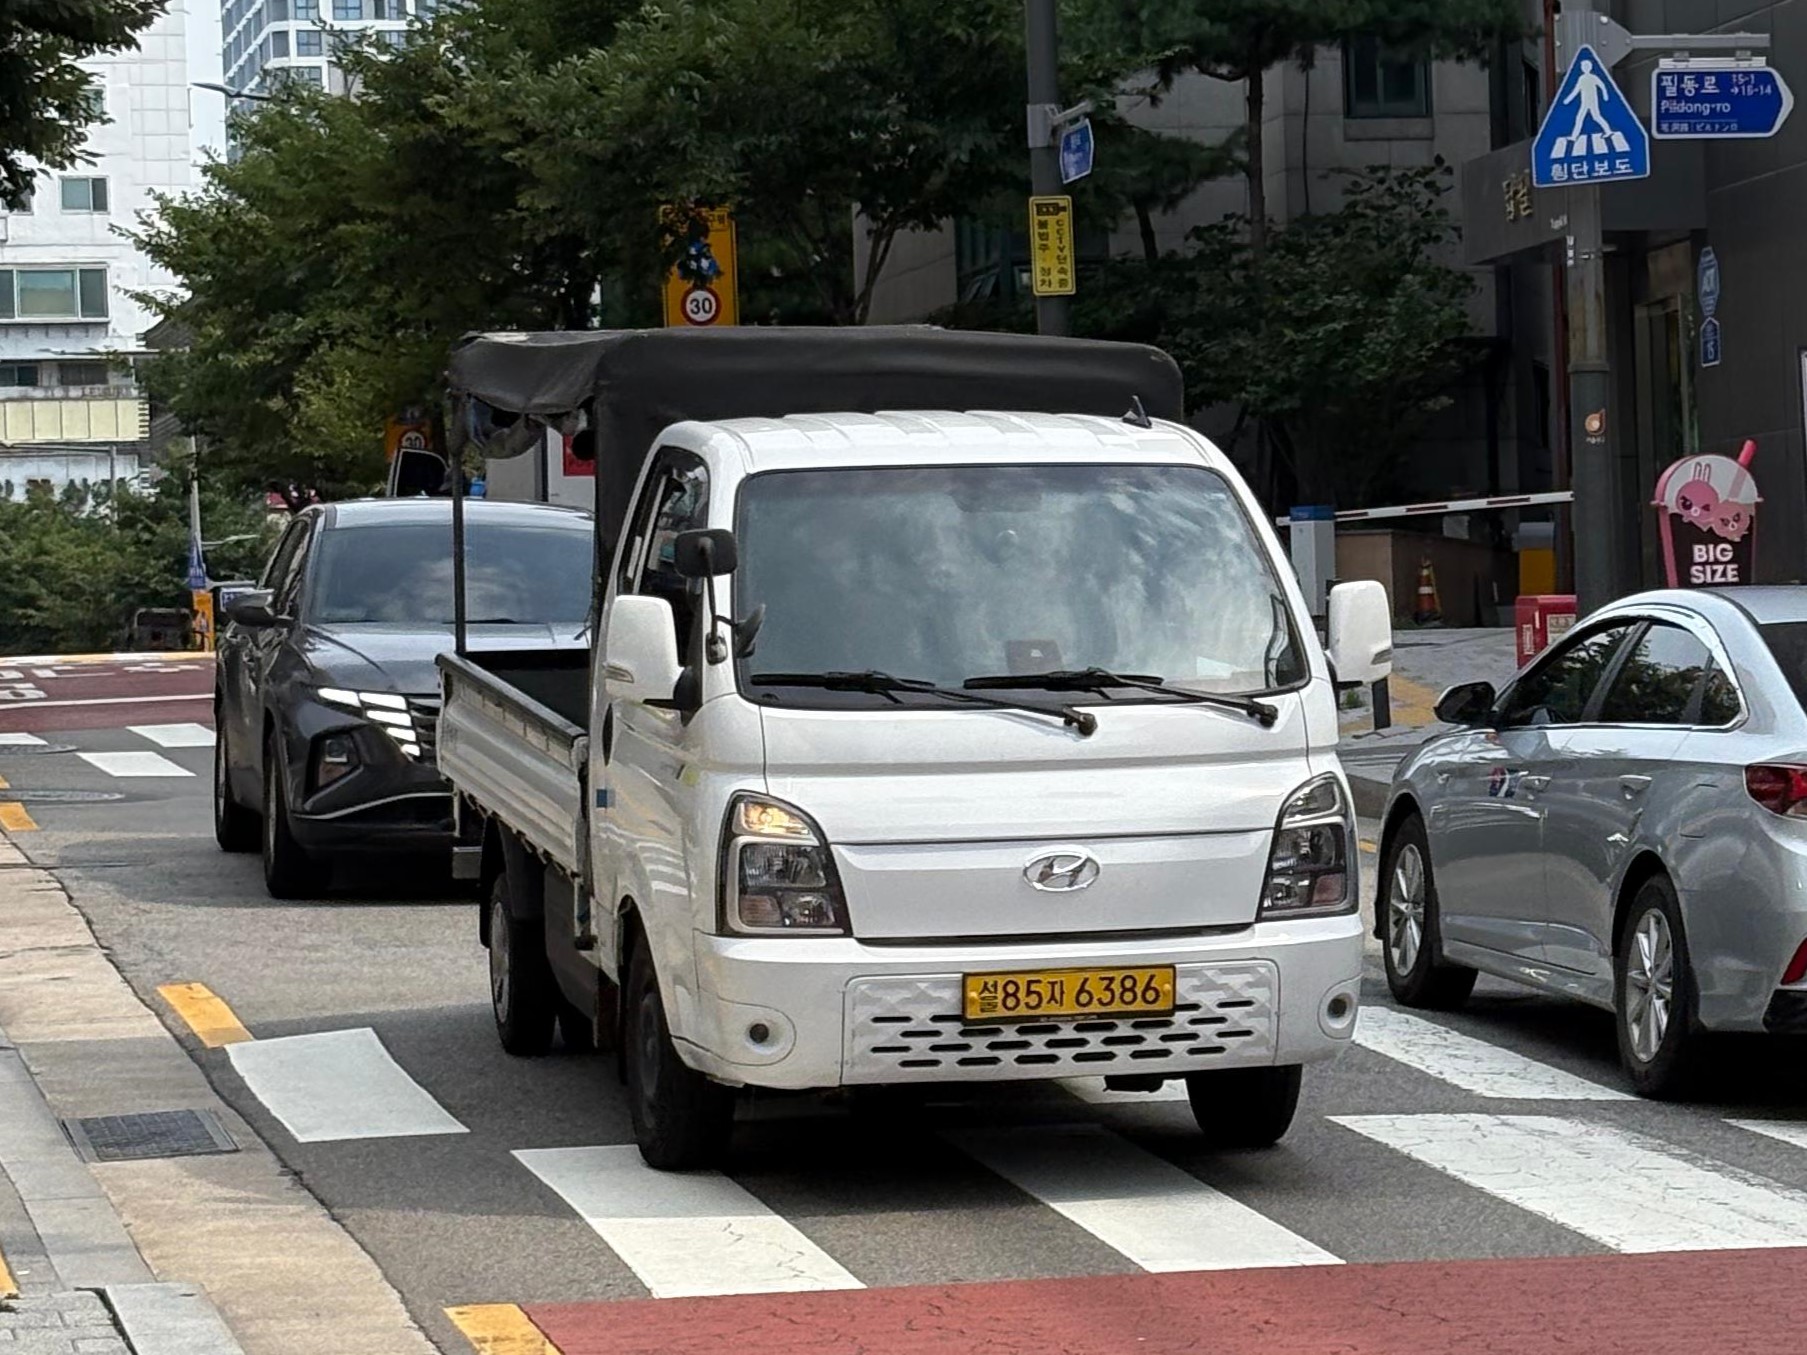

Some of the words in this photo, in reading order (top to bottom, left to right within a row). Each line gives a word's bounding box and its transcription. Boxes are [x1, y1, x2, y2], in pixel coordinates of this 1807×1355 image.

[1660, 74, 1720, 97] 필동로
[1660, 100, 1731, 116] Pildong-ro
[1551, 158, 1634, 181] 횡단보도
[689, 297, 713, 315] 30
[1692, 543, 1734, 563] BIG
[1690, 564, 1740, 584] SIZE
[1075, 974, 1161, 1007] 6386
